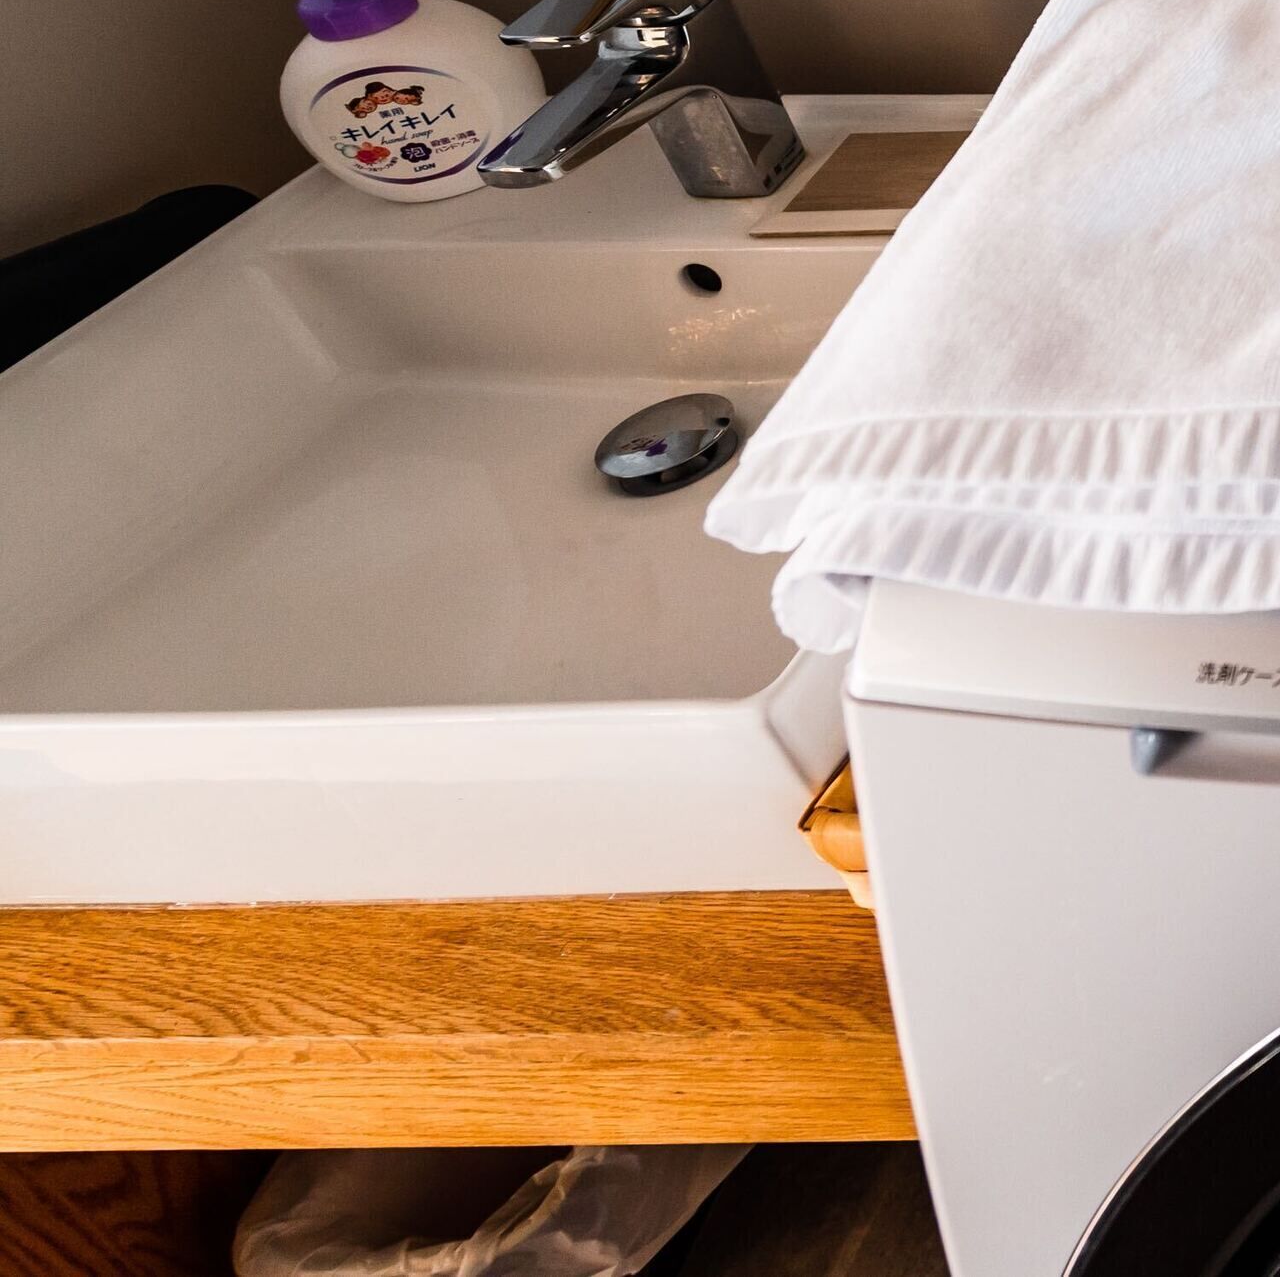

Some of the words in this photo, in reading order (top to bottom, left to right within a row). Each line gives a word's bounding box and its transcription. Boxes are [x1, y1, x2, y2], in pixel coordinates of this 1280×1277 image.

[341, 104, 457, 142] キレイキレイ
[405, 147, 426, 159] 泡
